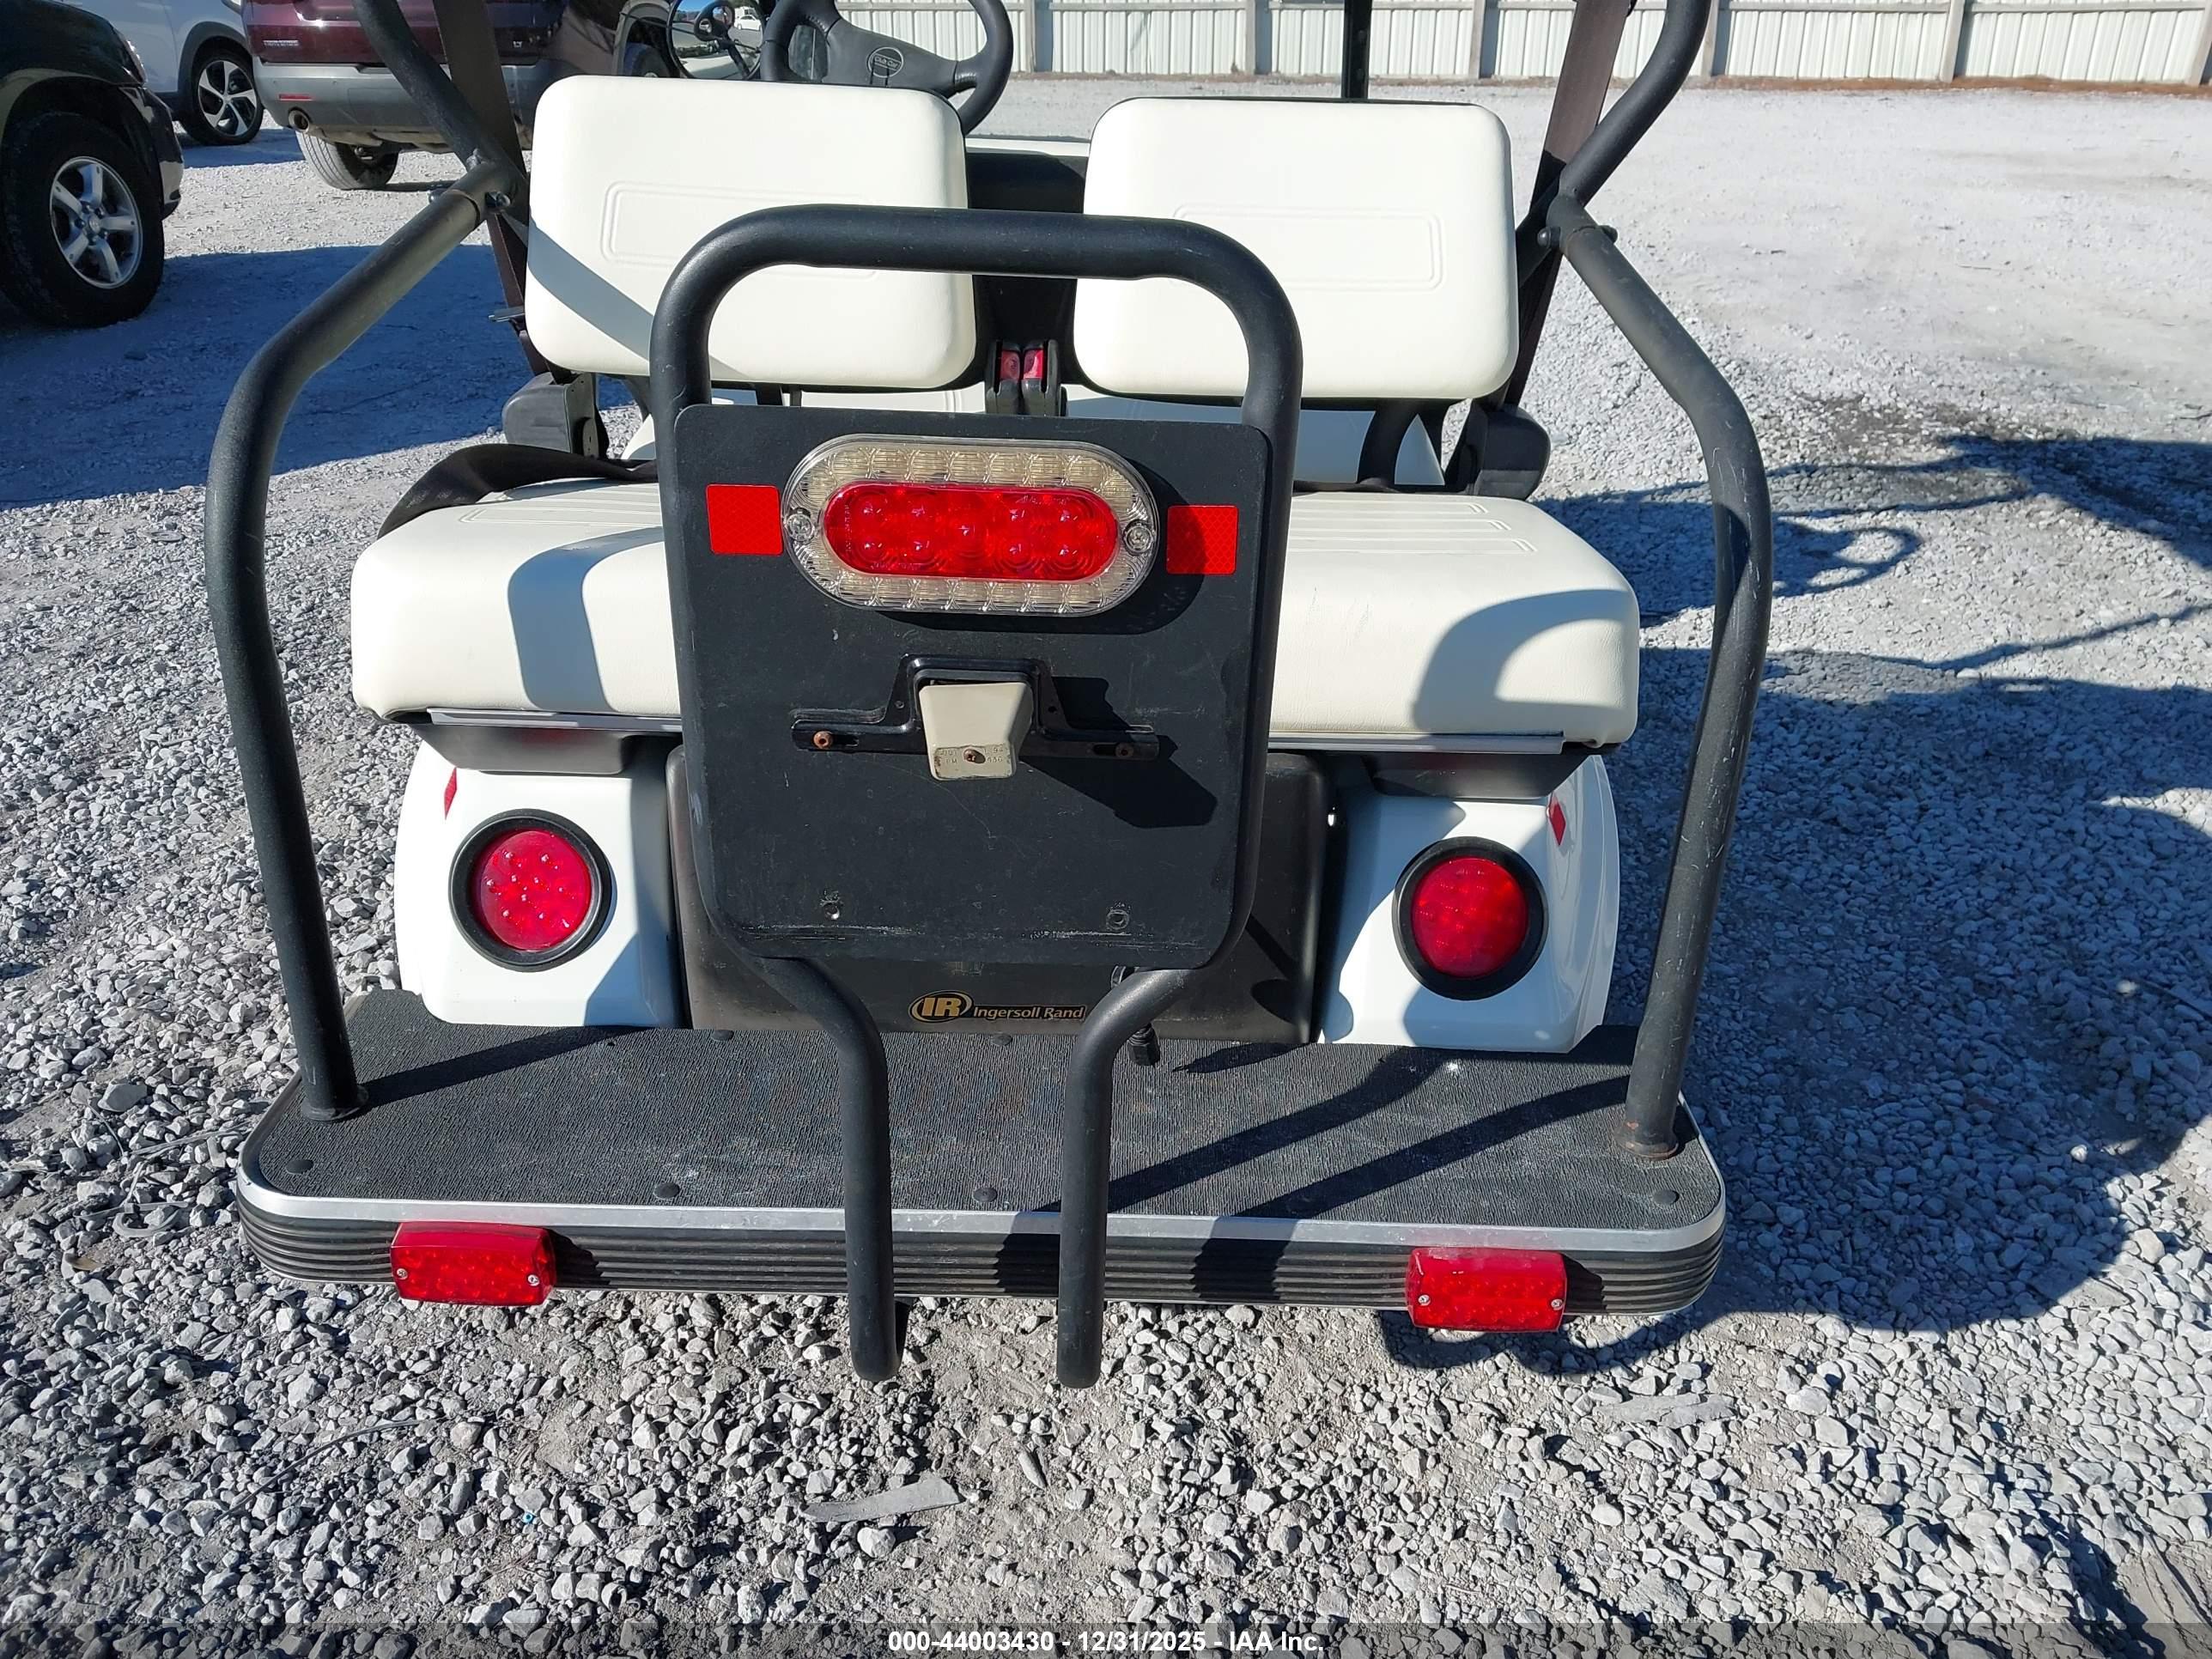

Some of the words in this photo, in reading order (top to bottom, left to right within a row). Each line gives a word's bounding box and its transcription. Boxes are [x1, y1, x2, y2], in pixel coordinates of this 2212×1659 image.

[921, 997, 962, 1018] IR
[973, 1006, 1039, 1020] Ingersoll
[1043, 1006, 1085, 1020] Rand
